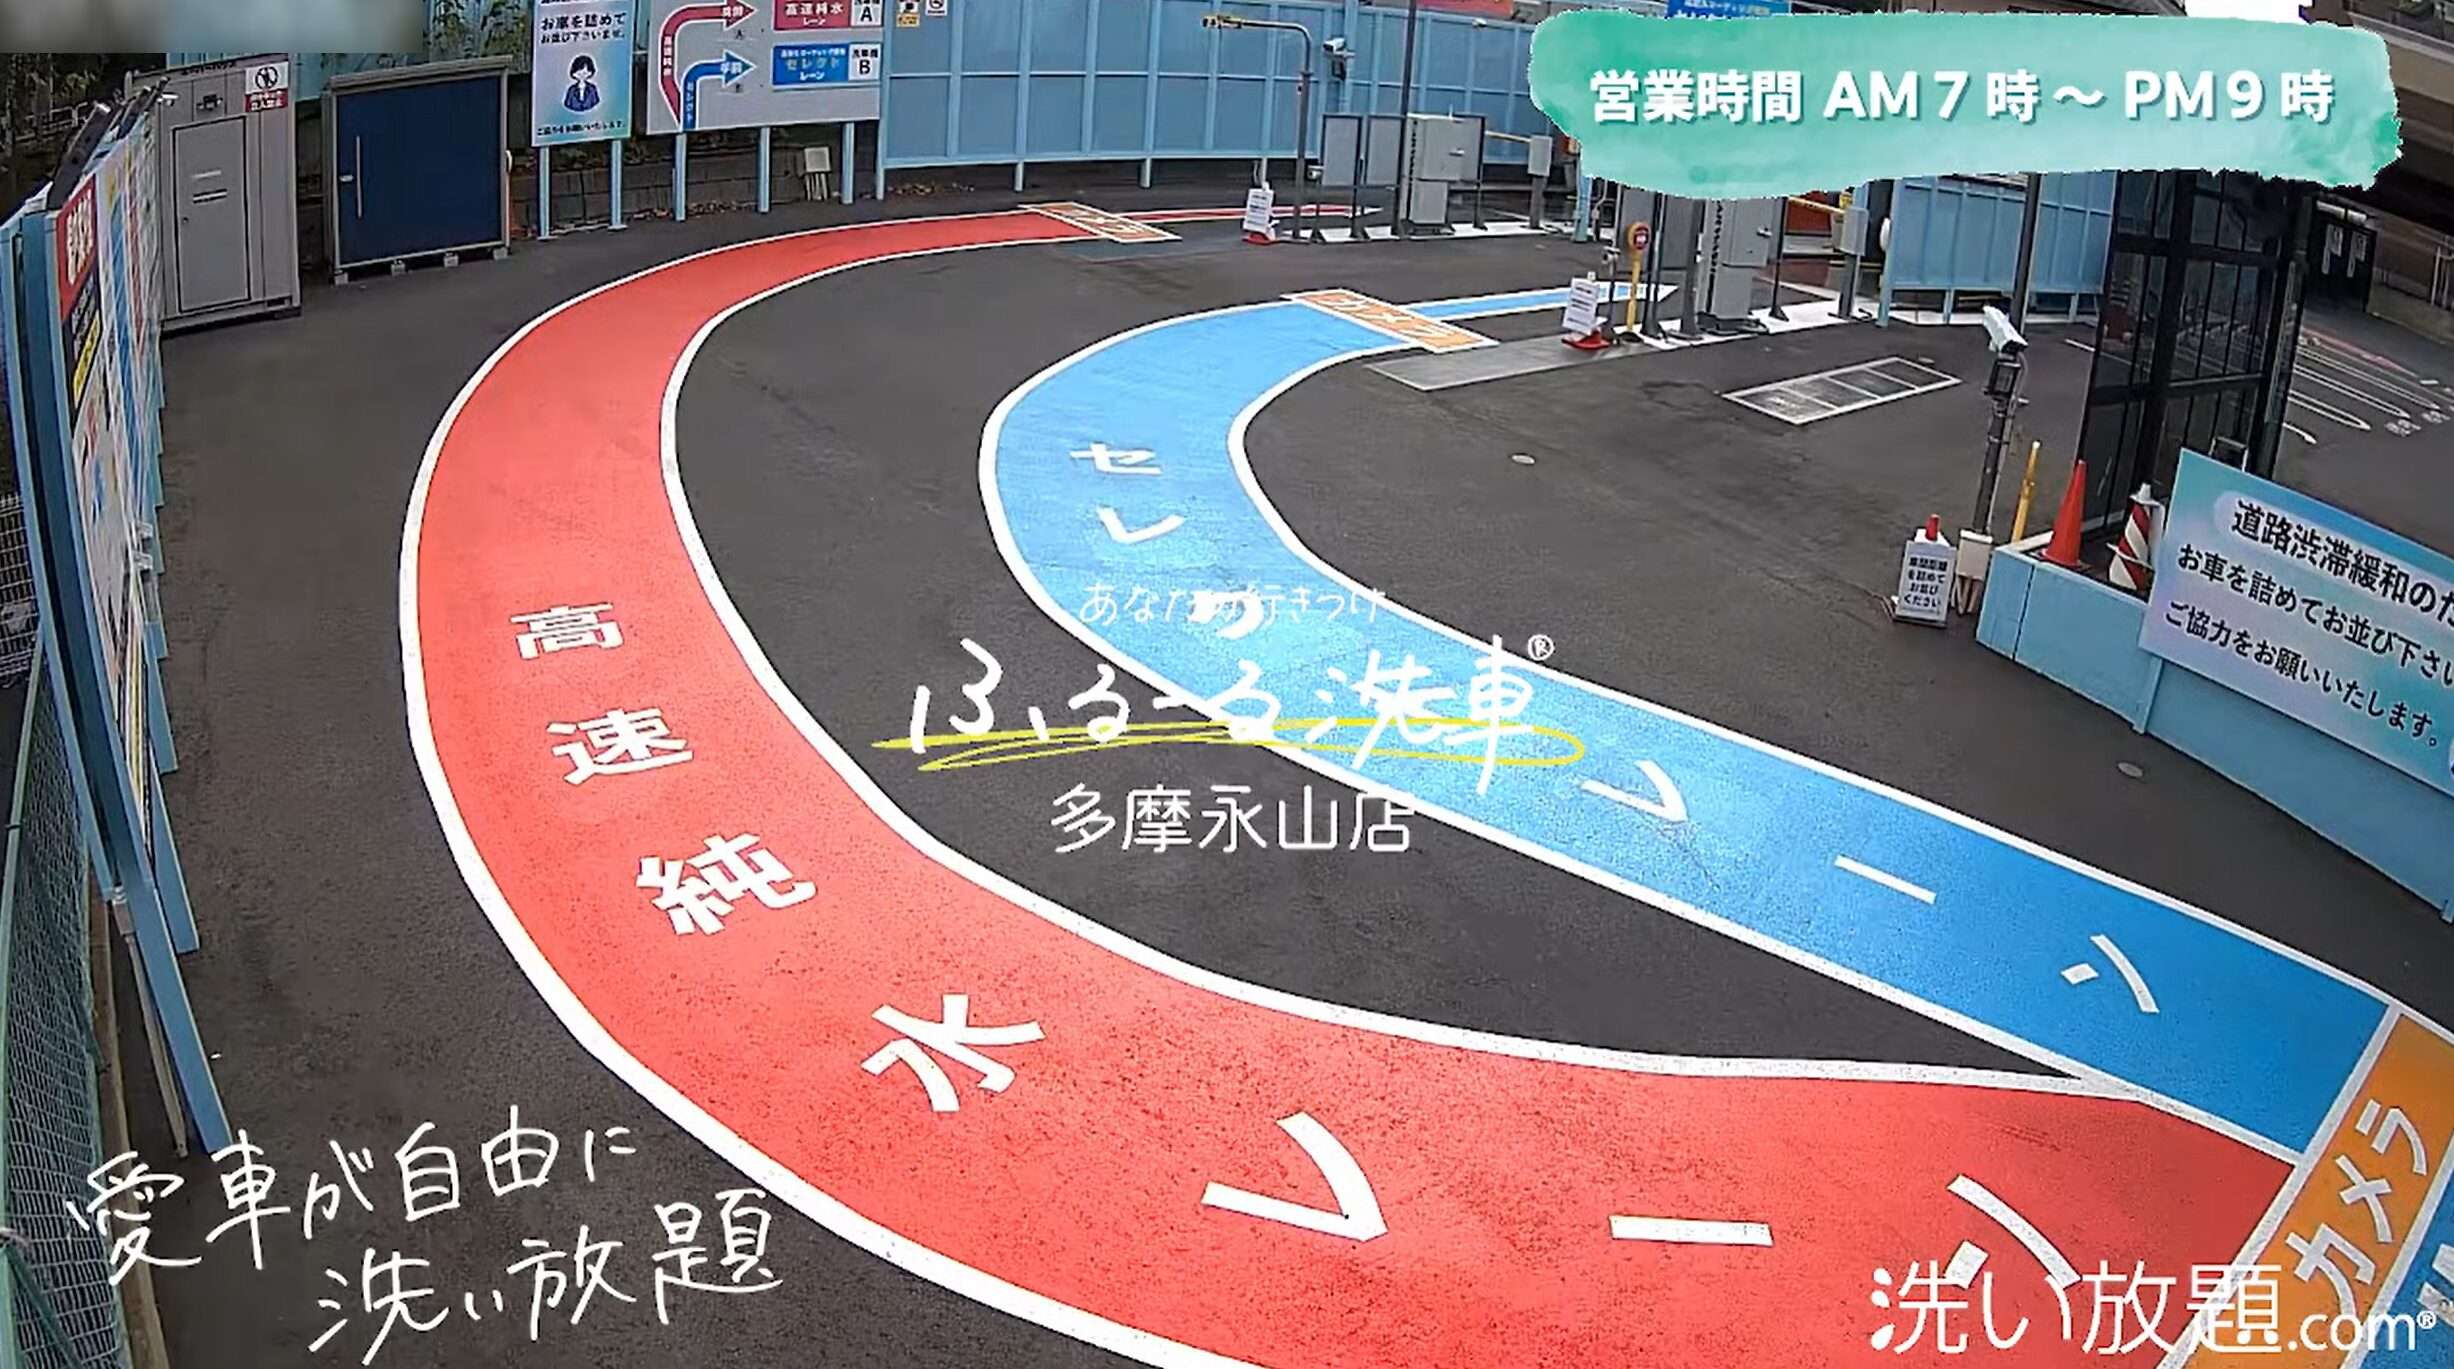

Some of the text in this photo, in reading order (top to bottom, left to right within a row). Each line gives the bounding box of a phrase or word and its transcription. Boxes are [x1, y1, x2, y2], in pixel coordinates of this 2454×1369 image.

[860, 6, 872, 22] A
[859, 59, 871, 75] B
[1904, 594, 1941, 608] ください
[2165, 601, 2438, 748] ご協力をお願いいたします。
[2284, 1097, 2428, 1323] カメラ
